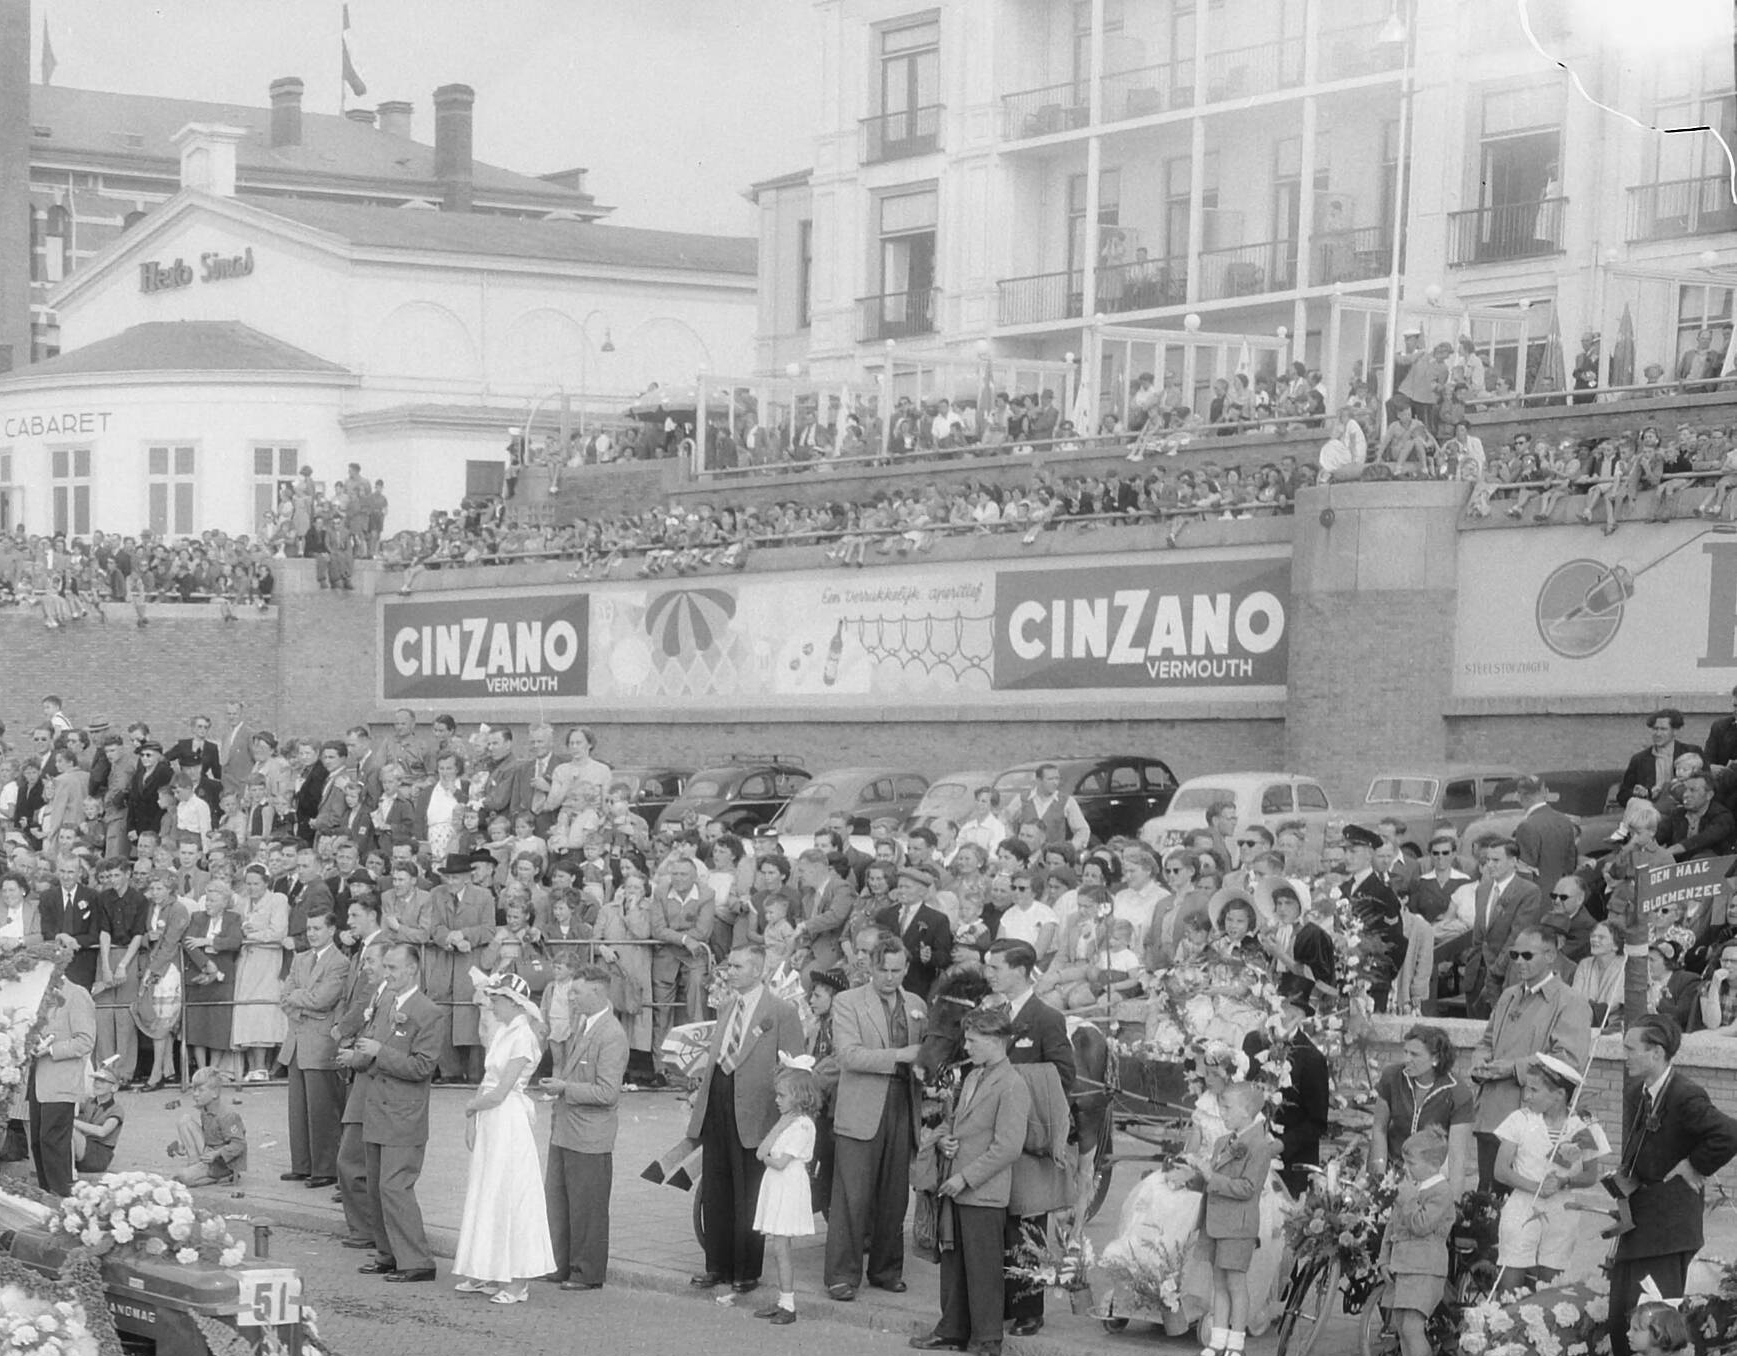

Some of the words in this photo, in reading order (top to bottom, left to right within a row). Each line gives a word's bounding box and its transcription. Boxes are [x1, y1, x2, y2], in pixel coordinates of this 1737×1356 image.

[5, 412, 112, 438] CABARET
[1009, 589, 1285, 664] CINZANO
[393, 618, 578, 680] CINZANO
[1147, 659, 1253, 679] VERMOUTH
[486, 676, 559, 692] VERMOUTH
[1650, 868, 1670, 885] DEN
[1676, 861, 1710, 877] HAAG
[1643, 883, 1722, 912] BLOEMENZEE
[110, 1302, 156, 1324] ANOMAG
[254, 1282, 287, 1321] 51
